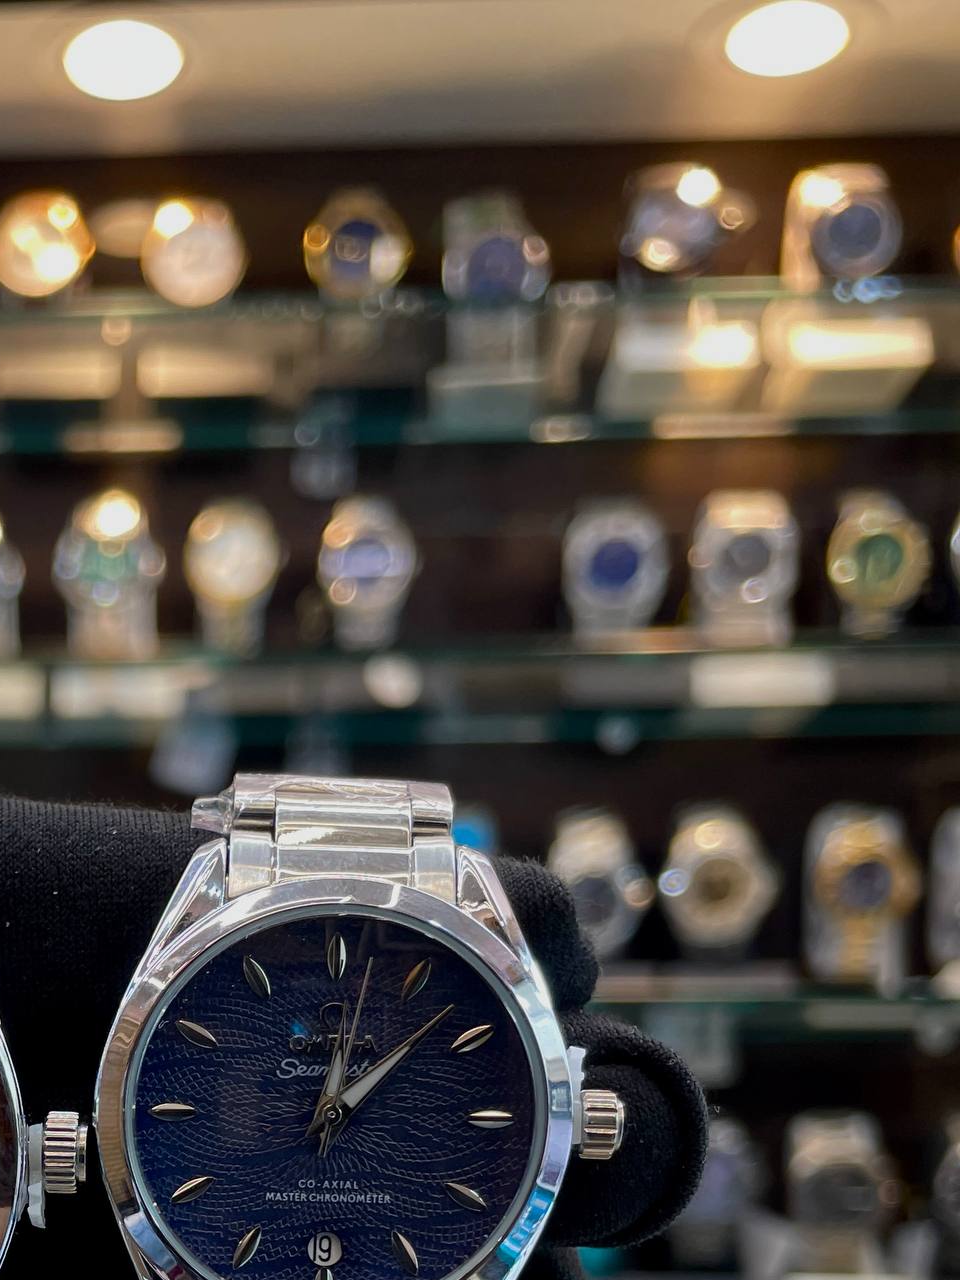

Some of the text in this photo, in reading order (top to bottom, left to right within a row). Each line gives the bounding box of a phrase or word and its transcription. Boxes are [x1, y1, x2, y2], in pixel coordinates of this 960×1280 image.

[298, 1179, 359, 1190] CO-AXIAL
[265, 1192, 391, 1204] MASTER CHRONOMETER
[313, 1235, 332, 1262] 19
